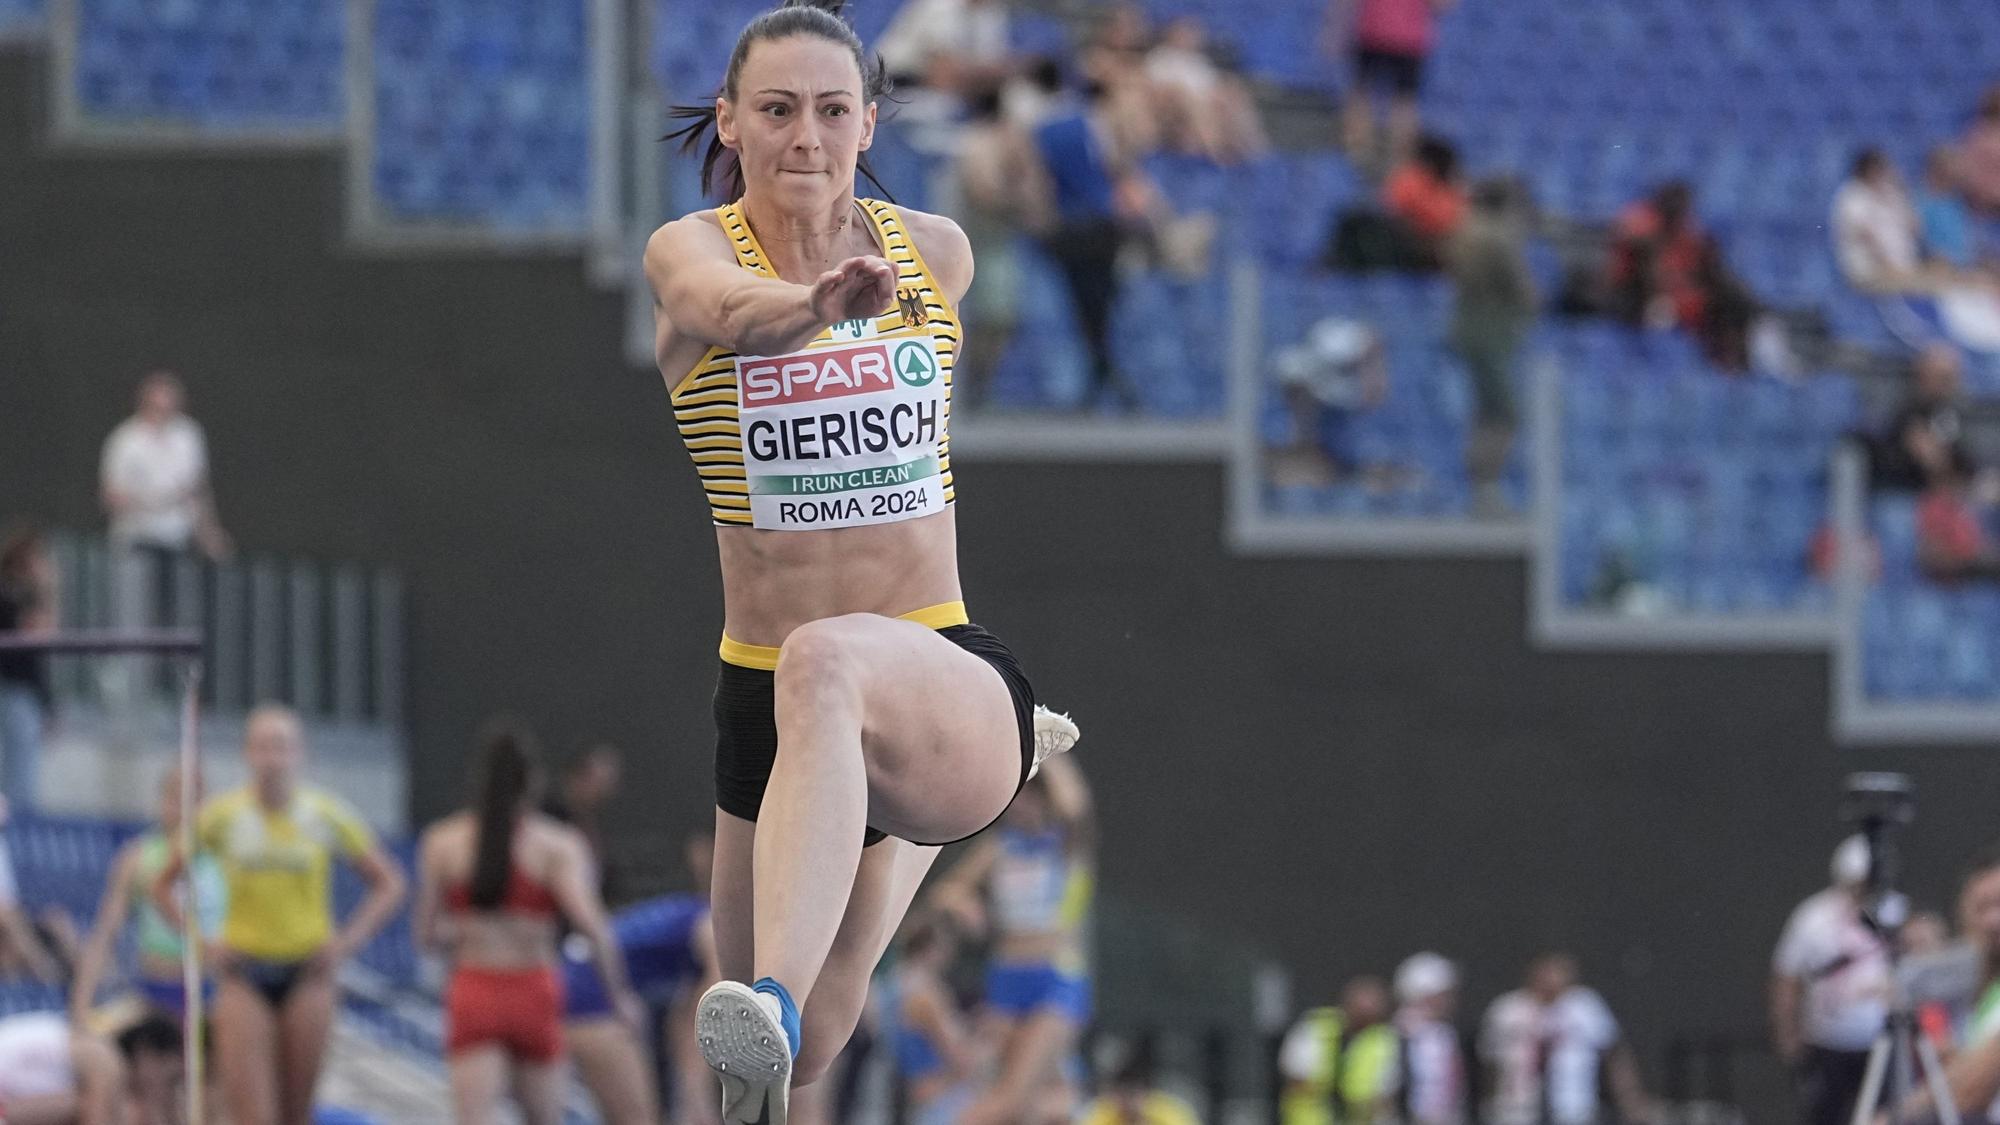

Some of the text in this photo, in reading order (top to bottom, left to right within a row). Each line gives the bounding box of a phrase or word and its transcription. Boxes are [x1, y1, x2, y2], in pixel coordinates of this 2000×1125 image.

[745, 352, 889, 401] SPAR
[747, 399, 937, 462] GIERISCH
[780, 487, 928, 523] ROMA 2024
[792, 477, 797, 492] I
[802, 477, 844, 492] RUN
